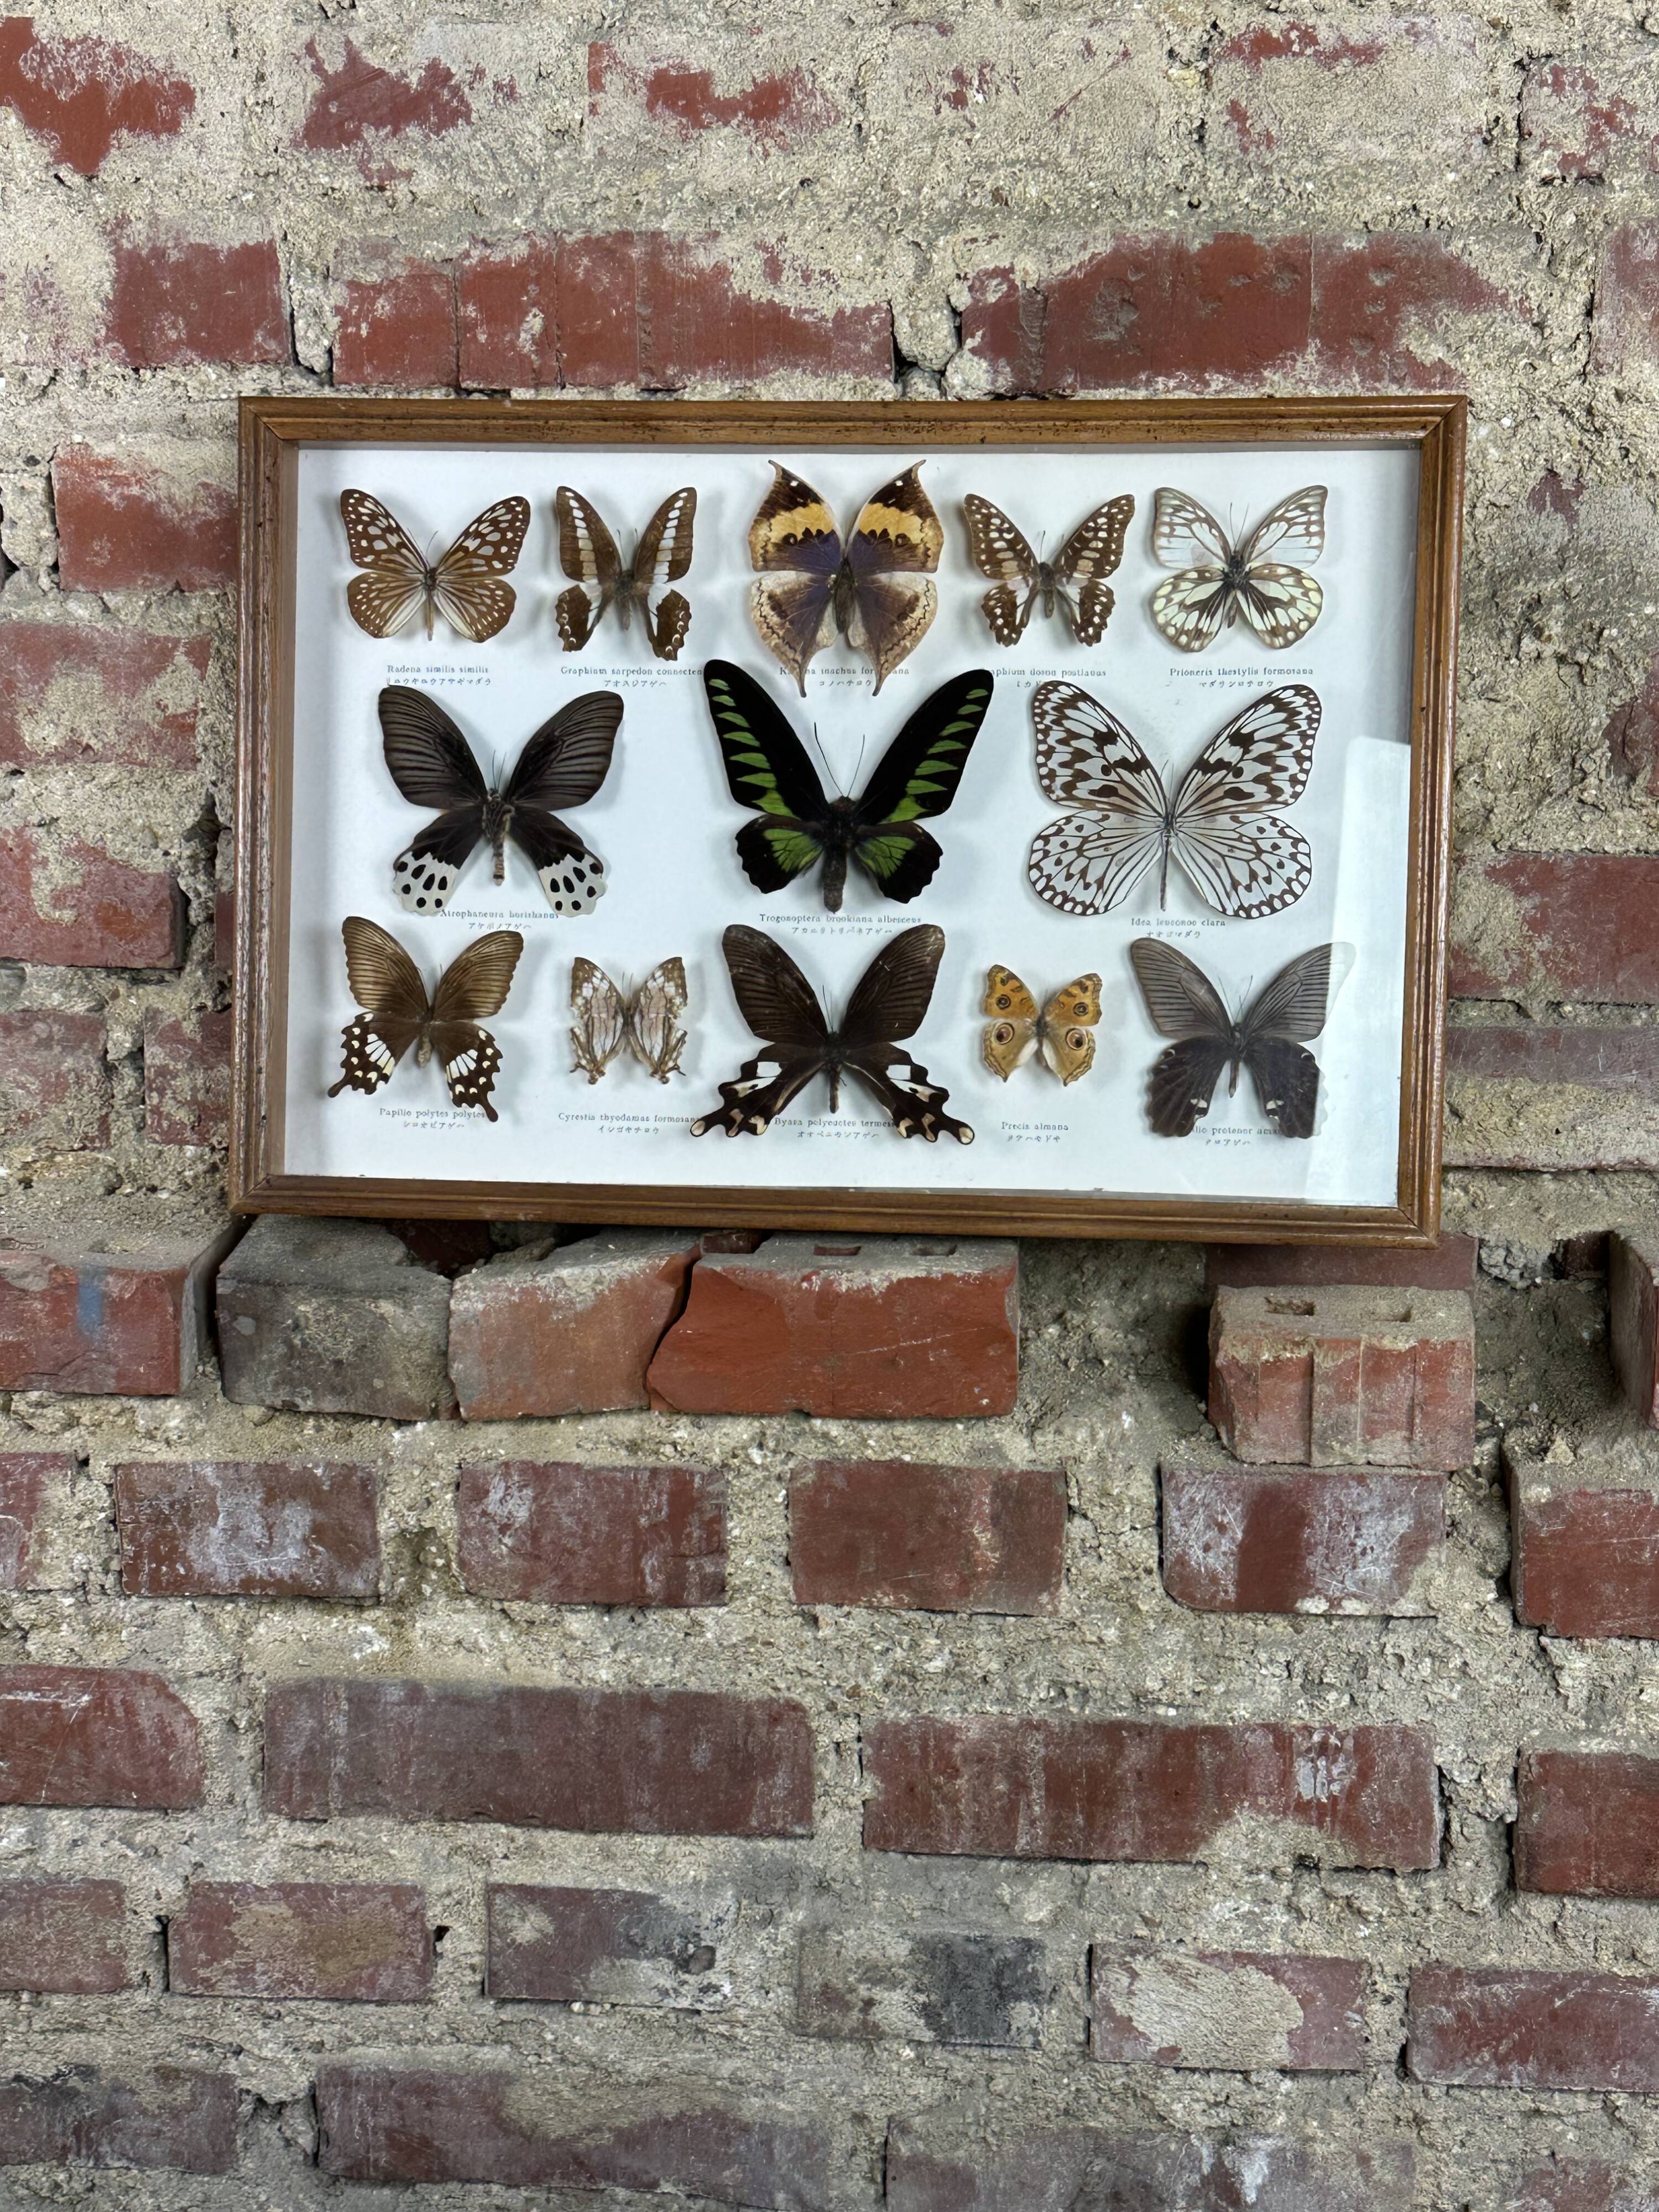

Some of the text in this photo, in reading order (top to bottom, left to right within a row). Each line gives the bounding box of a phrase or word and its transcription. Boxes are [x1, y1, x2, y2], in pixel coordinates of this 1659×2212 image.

[561, 666, 607, 676] Graphium
[612, 667, 653, 677] sarpedon
[1170, 668, 1213, 676] Prioneris
[1264, 666, 1313, 675] formosana
[760, 914, 821, 924] Trogonoptera
[826, 914, 873, 923] brookiana
[1131, 918, 1151, 926] Idea
[380, 1108, 412, 1118] Papilio
[416, 1109, 448, 1119] polytes
[775, 1118, 802, 1127] Byasa
[1001, 1121, 1030, 1130] Precis
